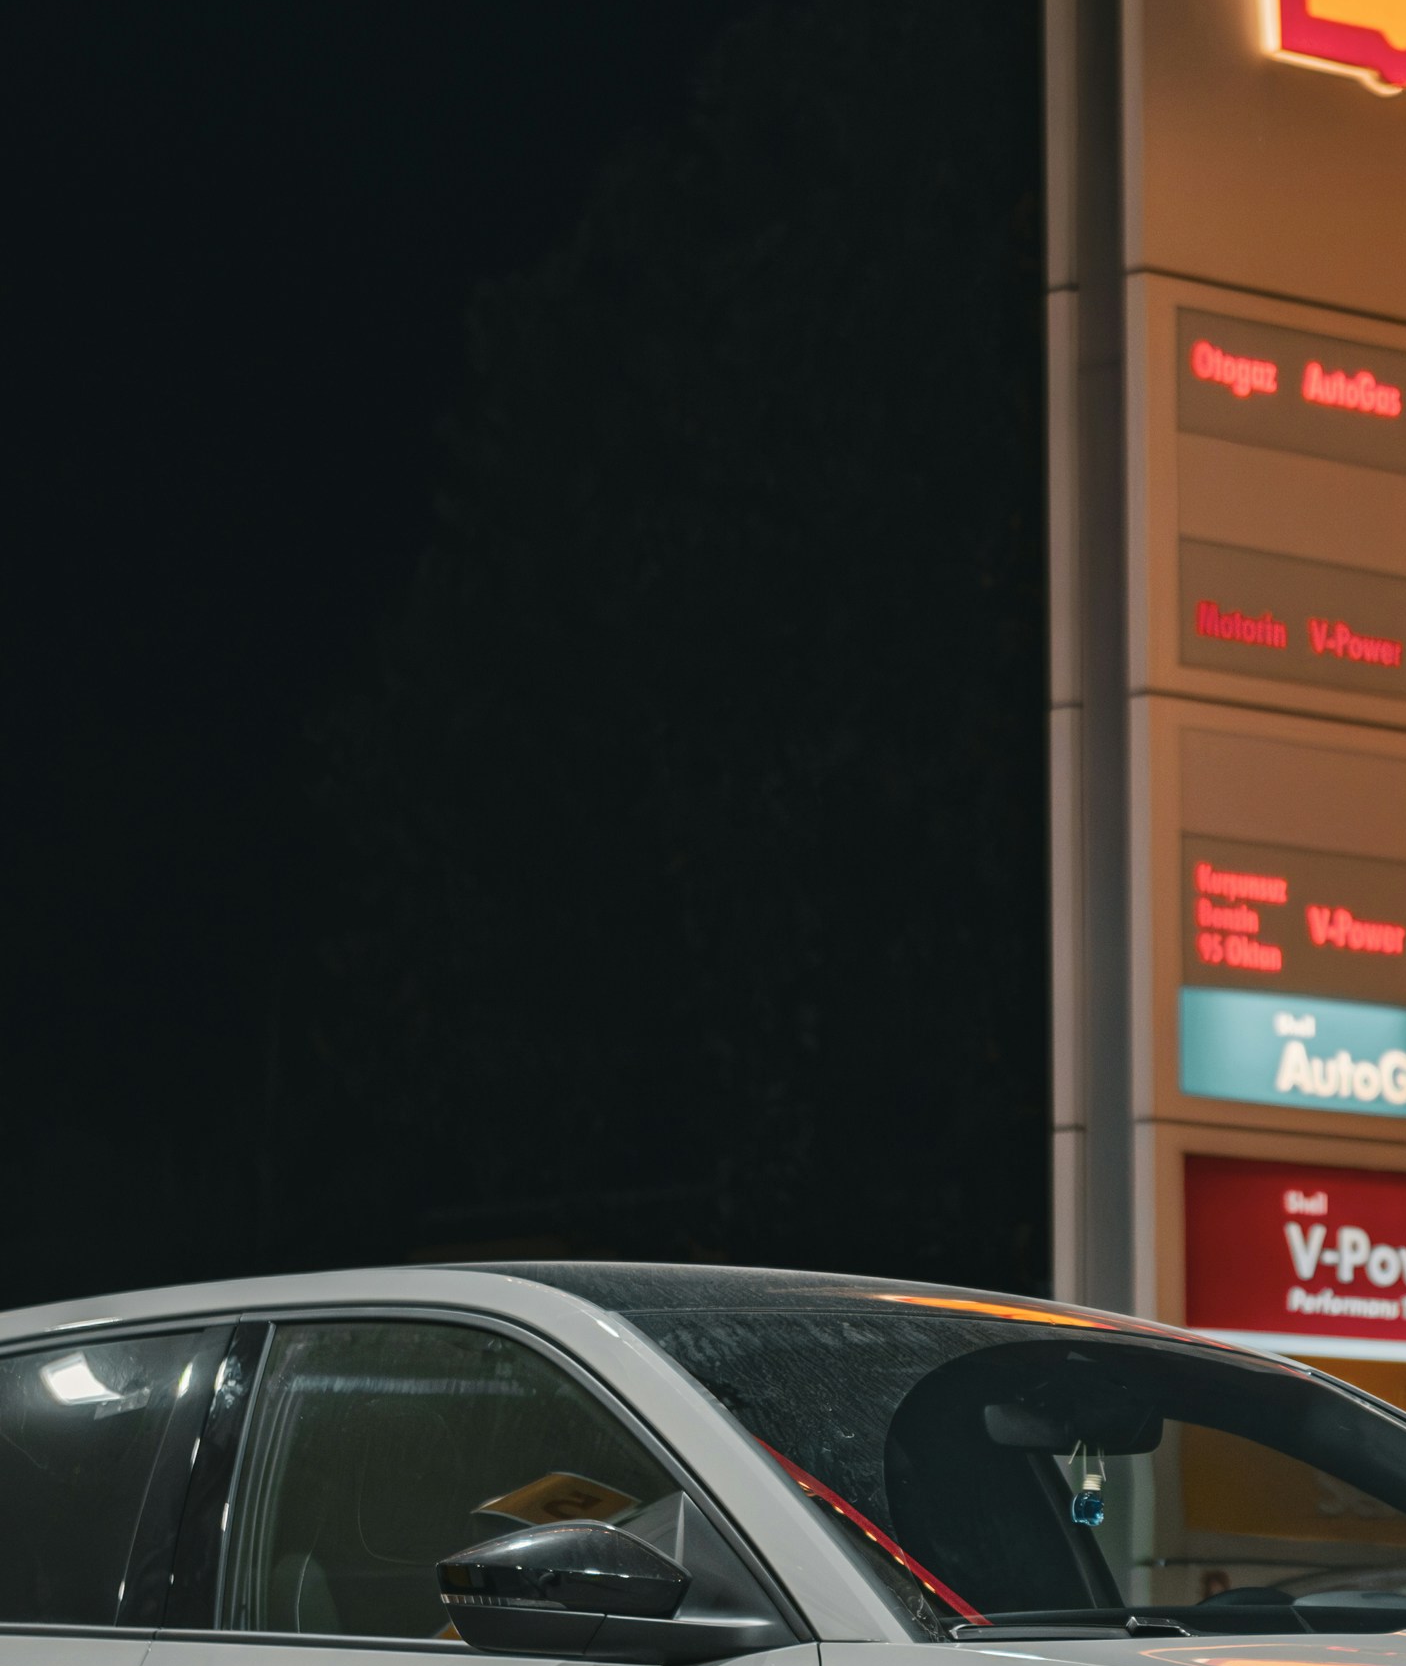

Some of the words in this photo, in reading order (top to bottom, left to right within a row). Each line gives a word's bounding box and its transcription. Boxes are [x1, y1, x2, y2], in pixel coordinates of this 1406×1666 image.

[1191, 341, 1278, 397] Otogaz
[1303, 361, 1402, 417] AutoGas
[1309, 618, 1402, 667] V-Power
[1307, 905, 1406, 955] V-Power
